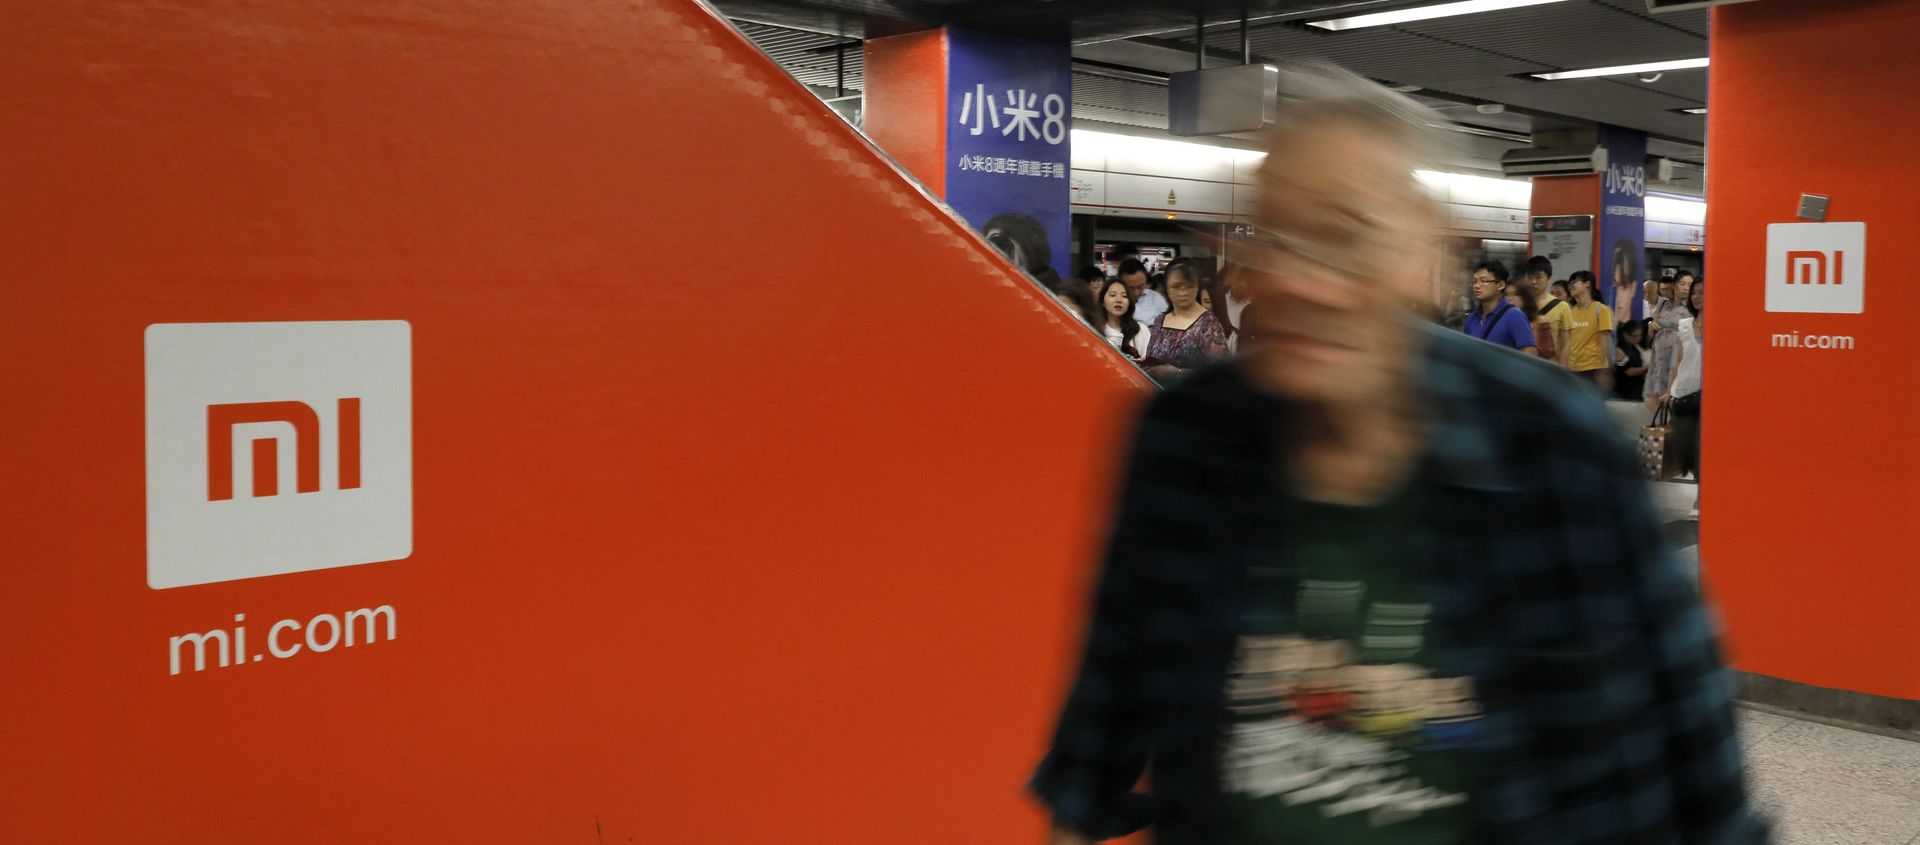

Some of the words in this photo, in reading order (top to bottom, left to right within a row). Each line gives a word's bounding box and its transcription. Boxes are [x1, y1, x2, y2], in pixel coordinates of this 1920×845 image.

[959, 84, 1066, 145] 小米8
[1606, 162, 1645, 198] 小米8
[1771, 330, 1854, 350] mi.com
[169, 604, 397, 676] mi.com
